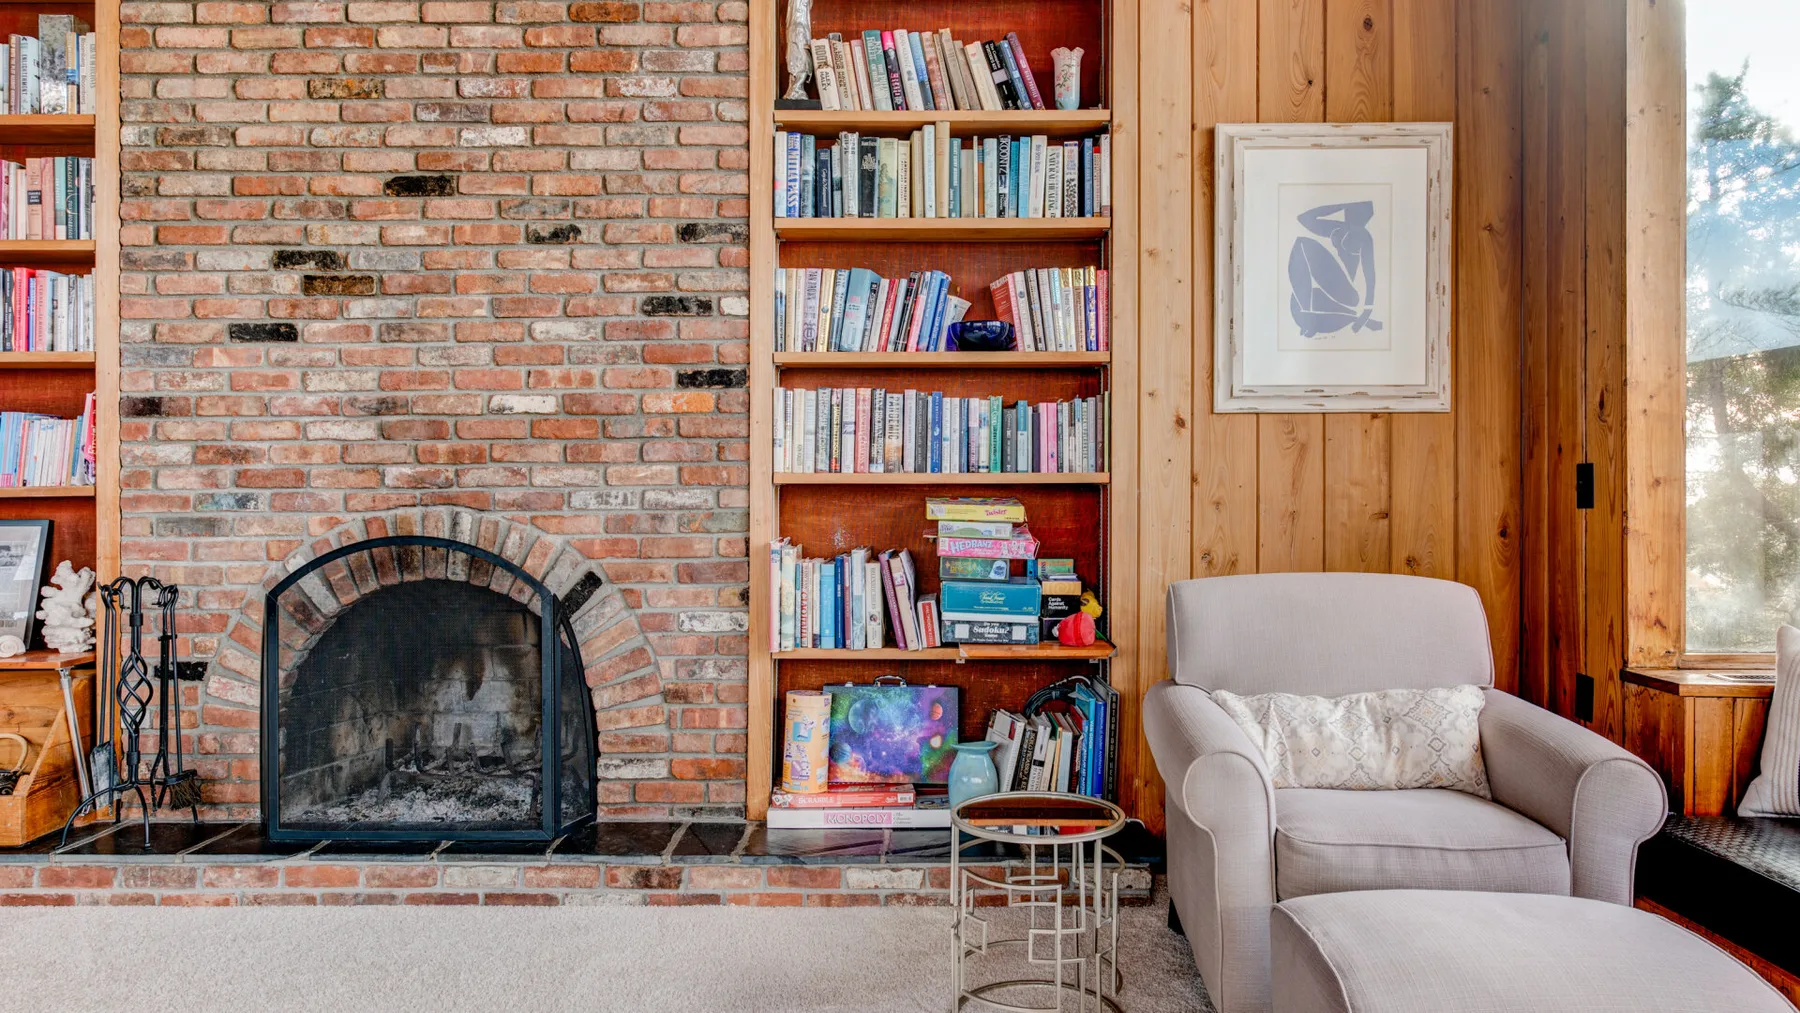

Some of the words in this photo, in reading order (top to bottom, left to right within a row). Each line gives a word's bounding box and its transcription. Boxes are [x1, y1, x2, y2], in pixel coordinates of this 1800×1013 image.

[788, 149, 800, 180] MITLA
[1000, 140, 1008, 174] KOONTZ
[788, 182, 800, 208] PASS
[1048, 183, 1056, 211] HEALING
[888, 396, 900, 440] PANDEMIC
[826, 812, 888, 824] MONOPOLY
